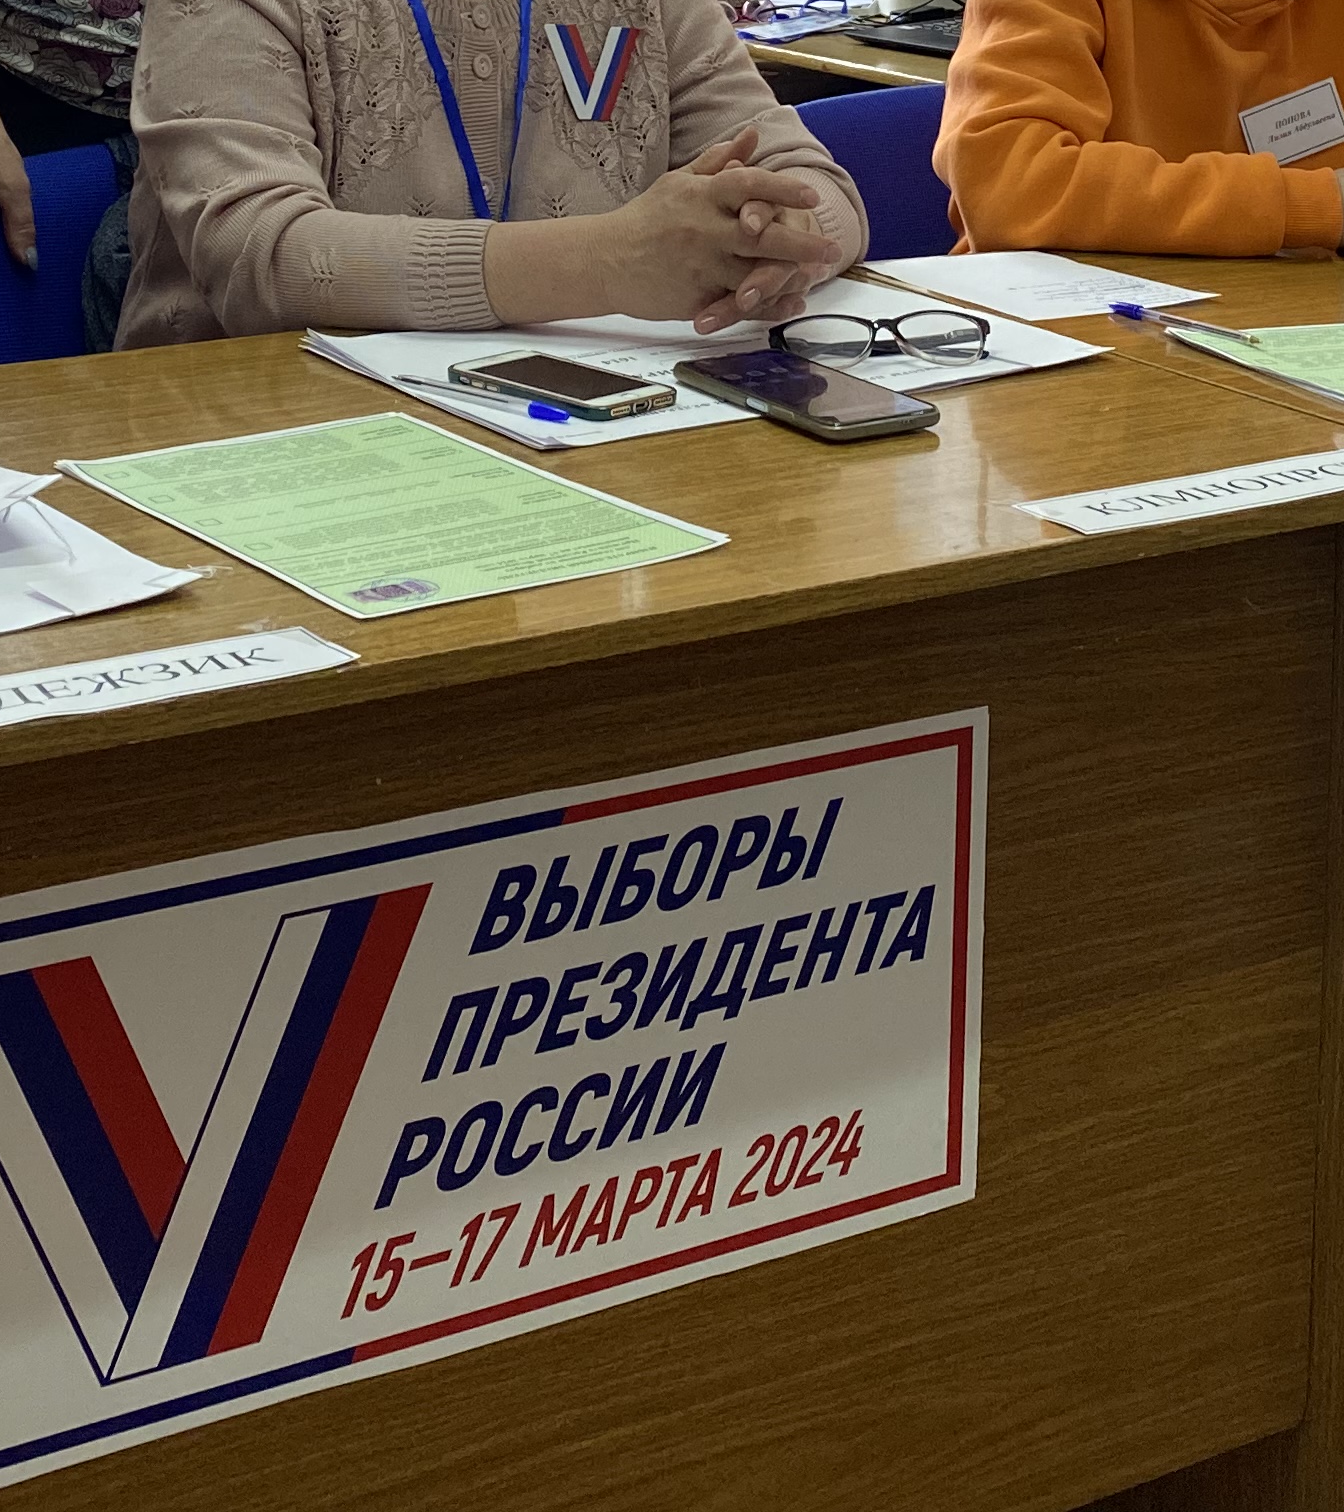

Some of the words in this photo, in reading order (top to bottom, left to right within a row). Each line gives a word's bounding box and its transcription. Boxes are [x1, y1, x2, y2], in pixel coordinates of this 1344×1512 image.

[1267, 130, 1292, 145] Лилия
[1274, 109, 1311, 129] ПОПОВА
[468, 797, 844, 956] ВЫБОРЫ
[422, 885, 936, 1084] ПРЕЗИДЕНТА
[374, 1042, 727, 1210] РОССИИ
[519, 1148, 722, 1267] МАРТА
[728, 1109, 865, 1208] 2024
